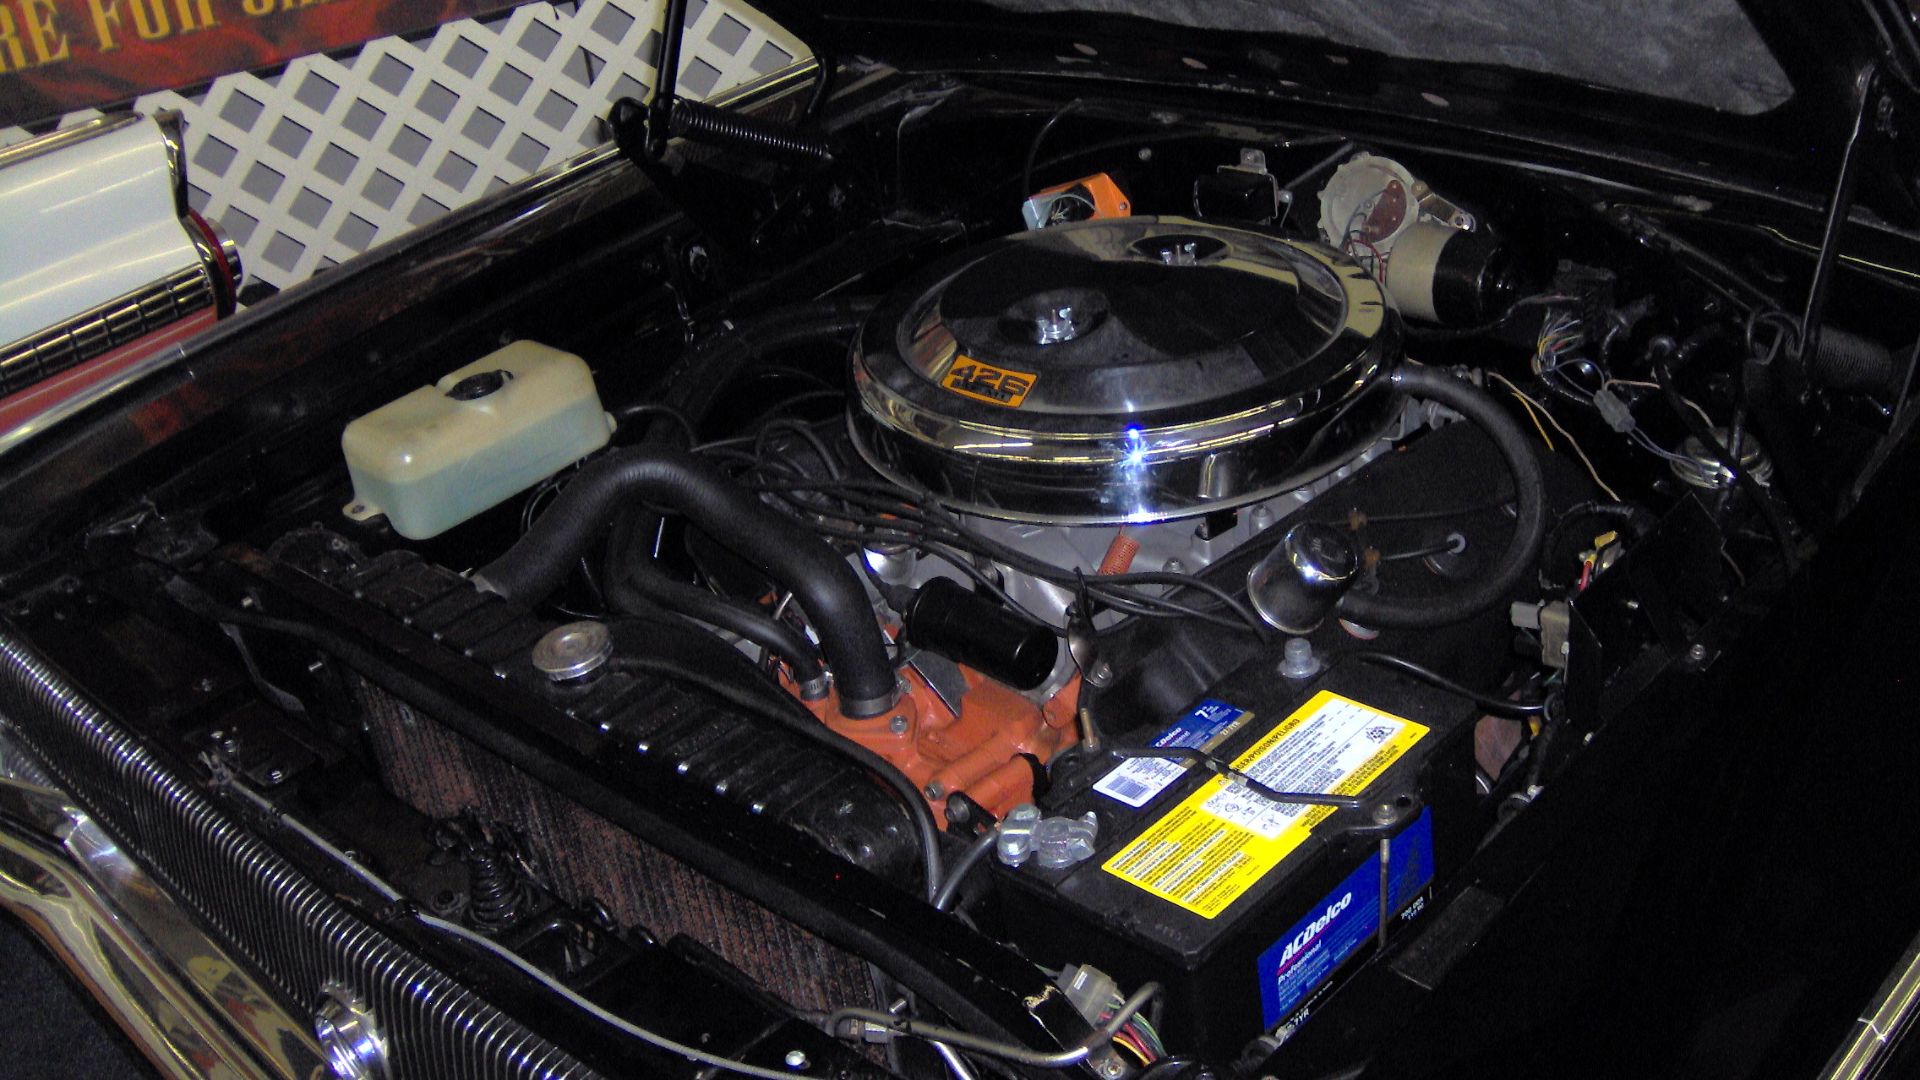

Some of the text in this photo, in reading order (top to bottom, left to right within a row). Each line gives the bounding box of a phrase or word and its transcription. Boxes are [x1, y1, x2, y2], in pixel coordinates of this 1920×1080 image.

[949, 365, 1030, 396] 426
[1154, 727, 1183, 747] CDelco
[1279, 891, 1352, 969] ACDelco
